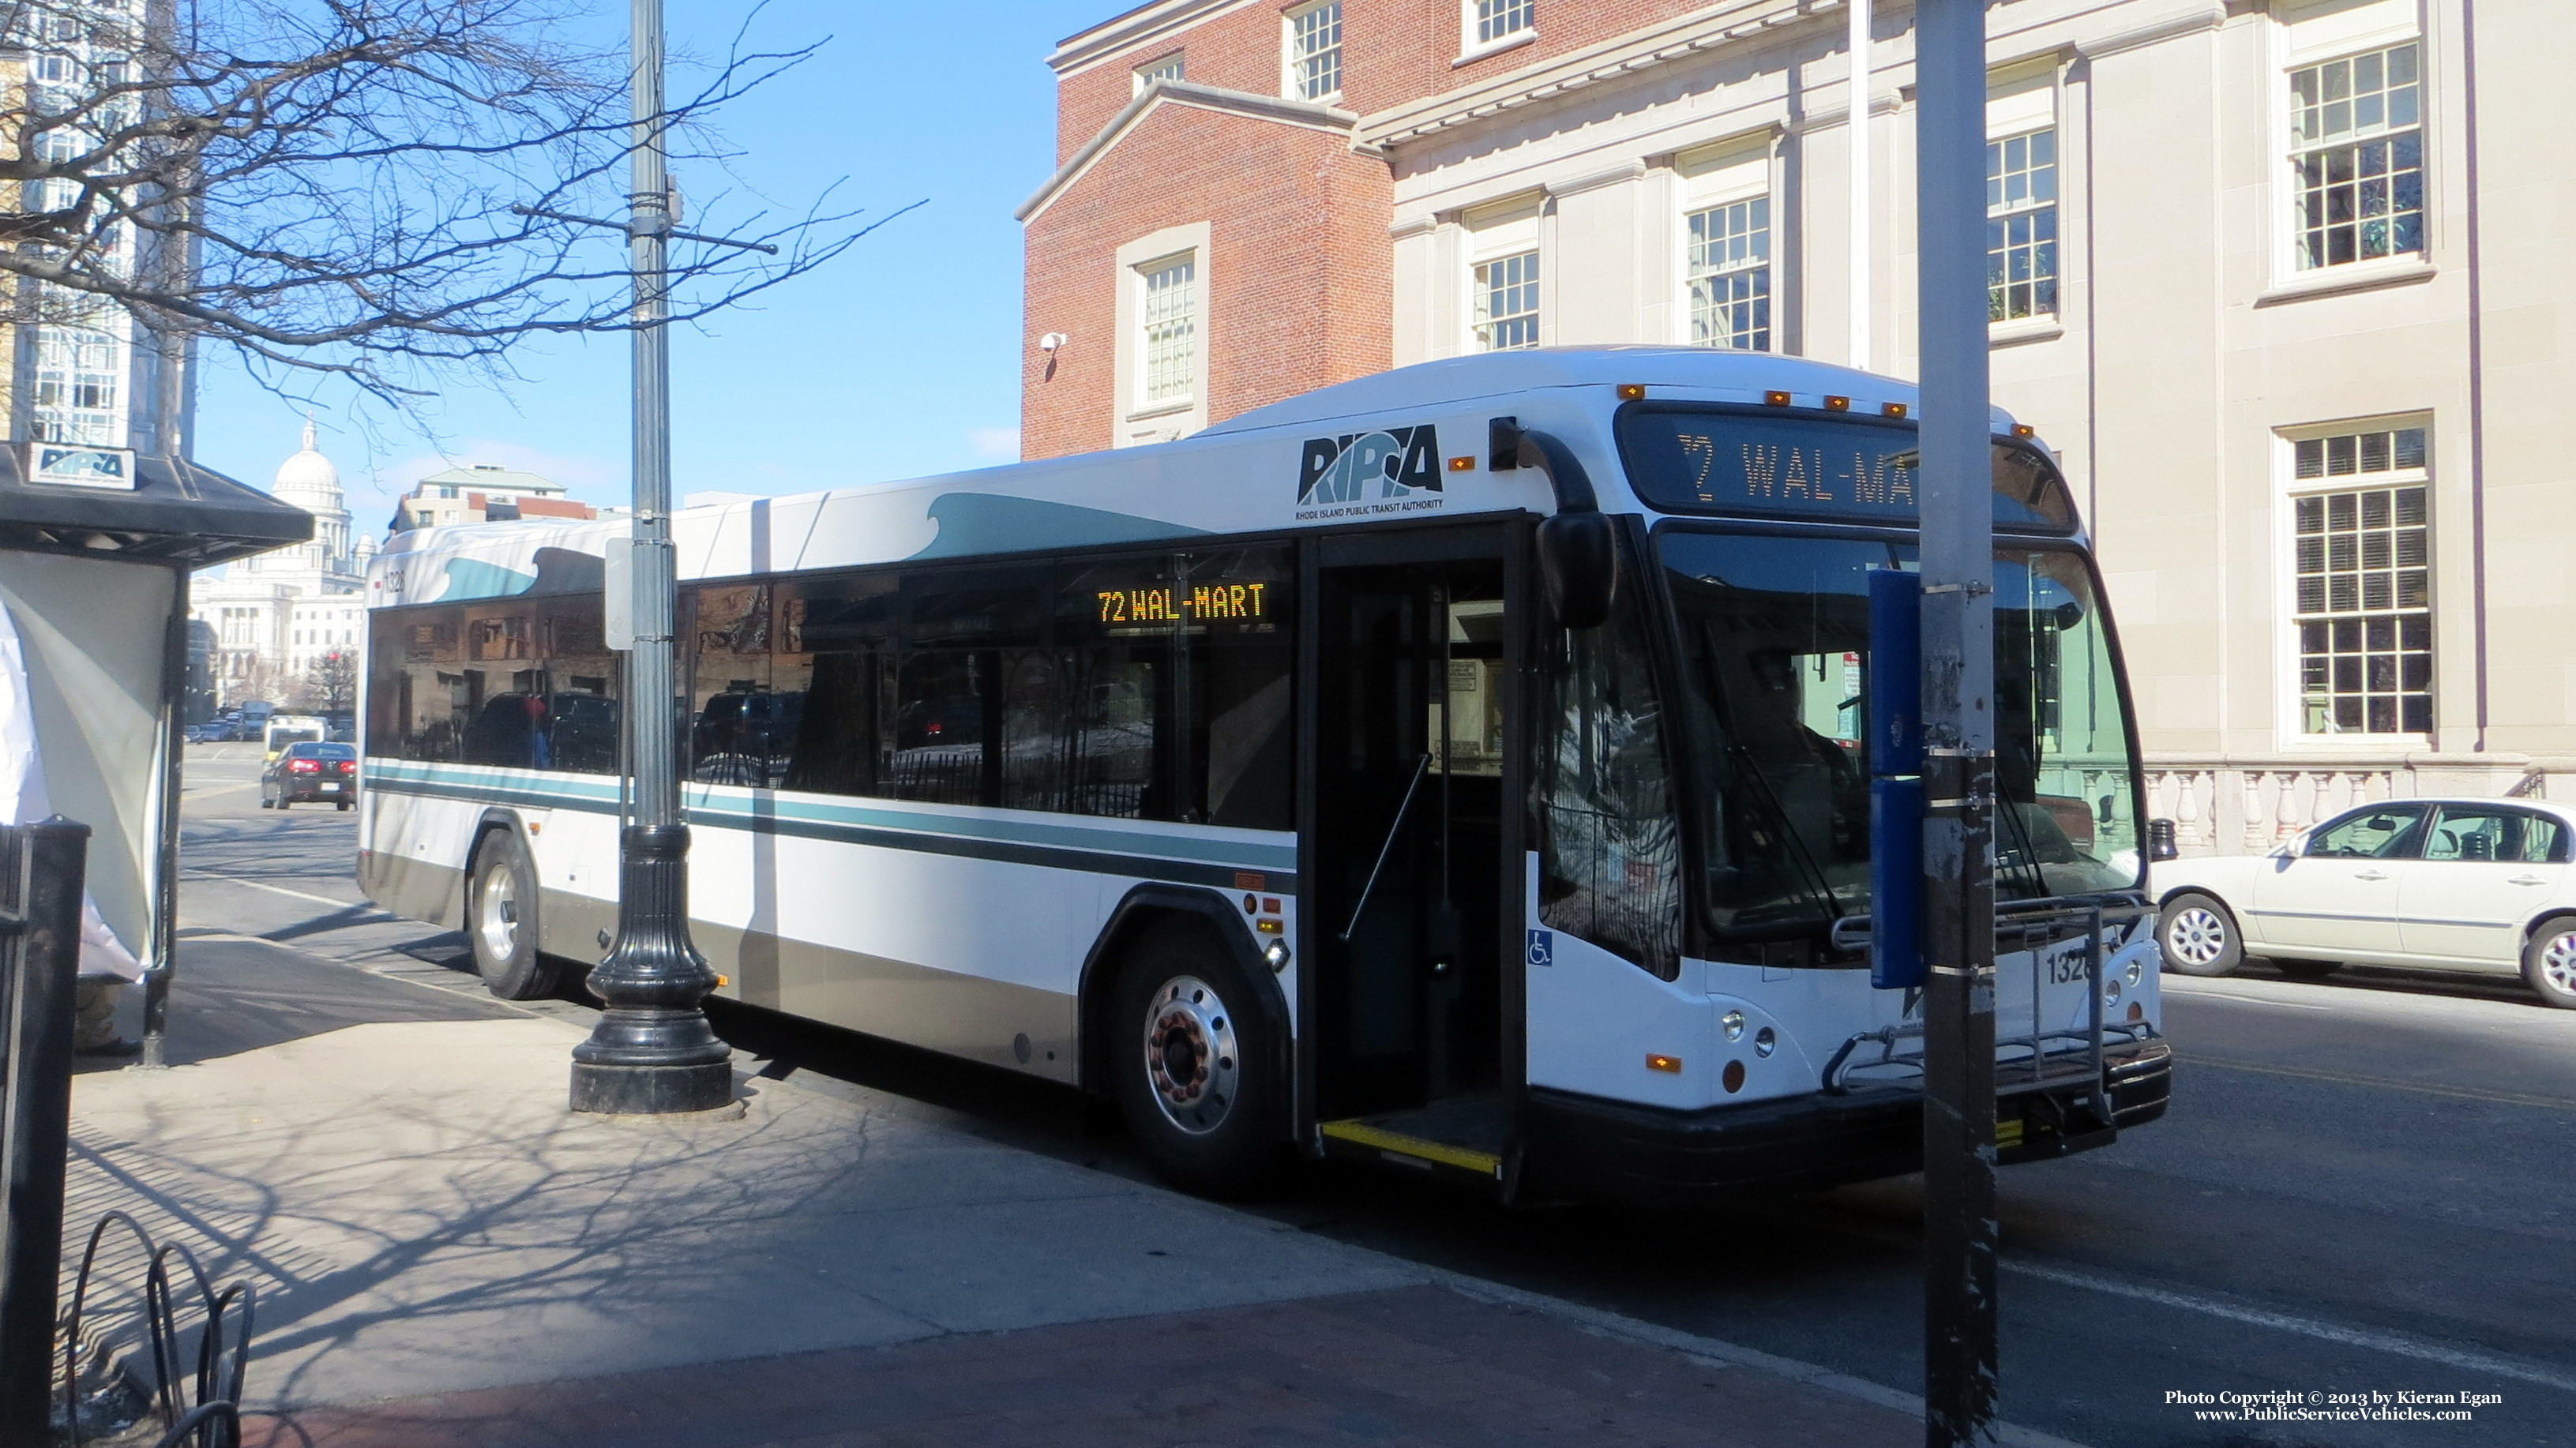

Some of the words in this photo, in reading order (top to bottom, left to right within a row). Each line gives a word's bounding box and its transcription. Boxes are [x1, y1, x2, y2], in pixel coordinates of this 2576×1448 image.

[40, 448, 124, 478] RIPTA
[1297, 424, 1444, 506] RIPTA
[1296, 511, 1318, 520] RHODE
[1320, 508, 1343, 519] ISLAND
[1346, 505, 1370, 516] PUBLIC
[1372, 503, 1400, 514] TRANSIT
[1402, 499, 1444, 512] AUTHORITY
[1098, 591, 1126, 622] 72
[1132, 583, 1264, 621] WAL-MART
